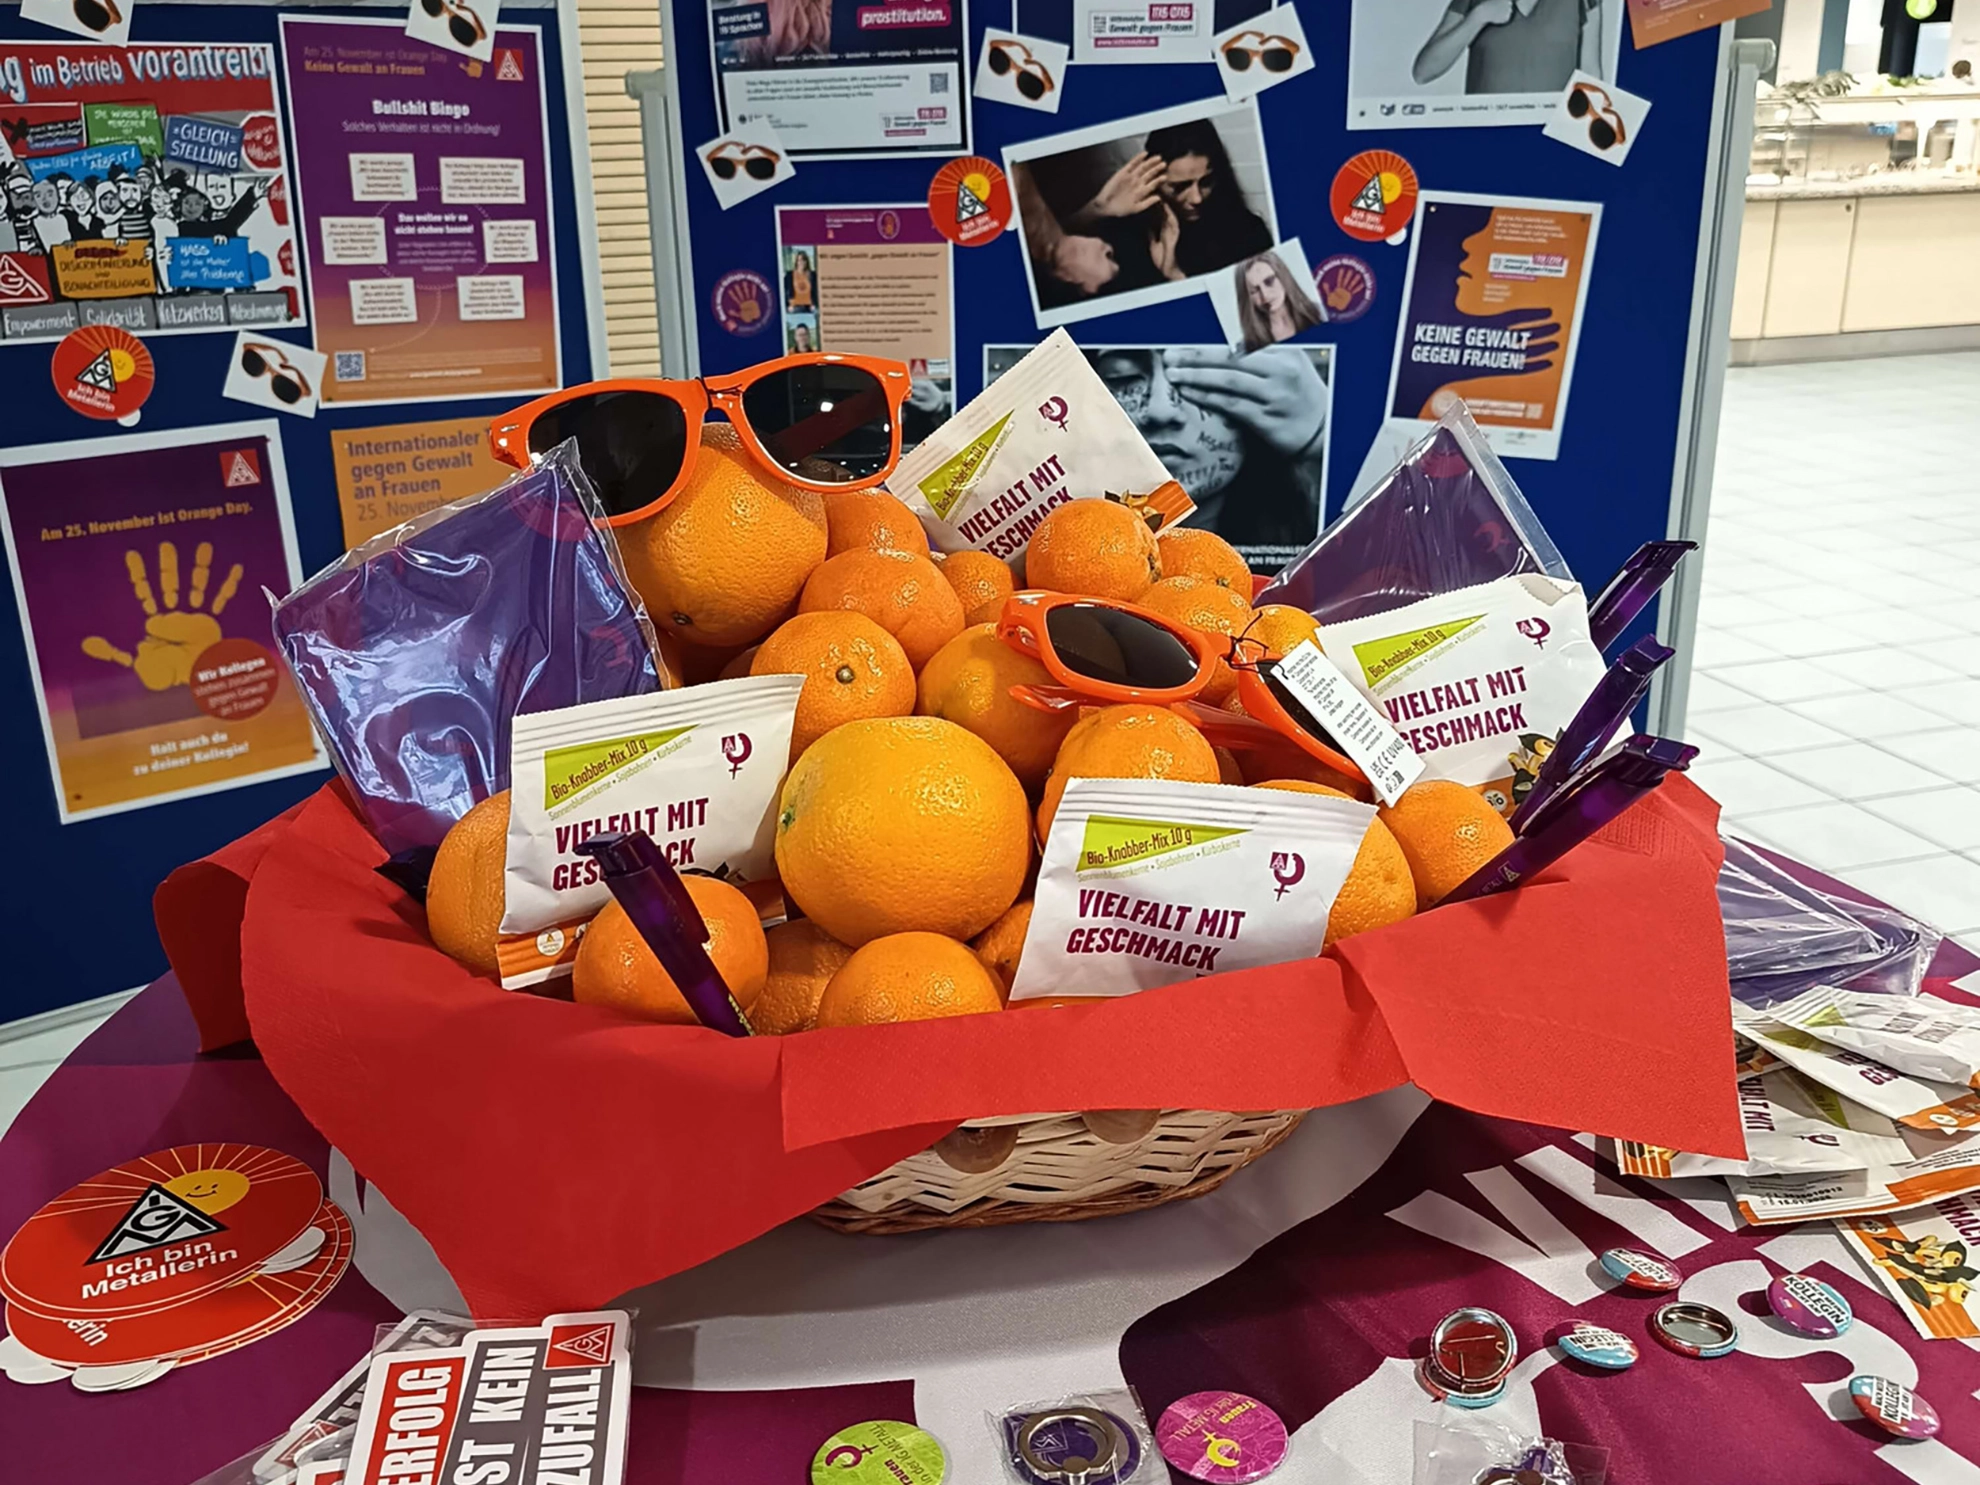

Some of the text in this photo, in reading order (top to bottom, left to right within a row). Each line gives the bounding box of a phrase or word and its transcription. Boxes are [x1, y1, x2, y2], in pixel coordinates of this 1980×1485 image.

[861, 8, 947, 27] prostitution.
[28, 46, 270, 90] im Betrieb vorantreib
[304, 60, 334, 73] Keine
[336, 61, 373, 74] Gewalt
[389, 63, 426, 76] Frauen
[372, 99, 470, 119] Bullshit Bingo
[180, 122, 230, 146] GLEICH
[169, 140, 239, 168] STELLUNG
[1414, 323, 1532, 350] KEINE GEWALT
[1411, 345, 1526, 370] GEGEN FRAUEN!
[348, 431, 482, 458] Internationaler
[351, 452, 474, 483] gegen Gewalt
[354, 477, 441, 500] an Frauen
[958, 480, 1033, 544] VIELFALT
[1028, 454, 1067, 493] MIT
[41, 501, 253, 542] Am 25. November ist Orange Day.
[387, 496, 456, 518] Novem
[1367, 638, 1429, 678] Bio-Knabber-Mix
[1423, 631, 1438, 645] 10
[1383, 676, 1481, 724] VIELFALT
[1486, 666, 1528, 697] MIT
[150, 739, 178, 756] Halt
[180, 733, 211, 752] auch
[150, 757, 191, 774] deiner
[194, 741, 249, 766] Kollegin!
[550, 738, 648, 800] Bio-Knabber-Mix 10 g
[549, 780, 613, 822] Sonnenblumenkerne
[667, 798, 710, 833] MIT
[1086, 826, 1193, 866] Bio-Knabber-Mix 10 g
[553, 838, 696, 892] GESCK
[1077, 864, 1150, 883] Sonnenblumenkerne
[1078, 888, 1247, 940] VIELFALT MIT
[1065, 927, 1222, 971] GESCHMACK
[1743, 1110, 1777, 1132] MIT
[80, 1246, 239, 1300] Metallerin
[105, 1240, 213, 1278] Ich bin
[1784, 1276, 1845, 1324] KOLLEGIN
[378, 1366, 452, 1485] ERFOLG
[453, 1346, 537, 1485] ST KEIN
[536, 1368, 602, 1485] ZUFALL
[1219, 1400, 1257, 1424] Frauen
[868, 1424, 901, 1452] METALL
[1168, 1414, 1208, 1442] METALL
[884, 1458, 914, 1485] rauen
[895, 1450, 912, 1464] IG
[907, 1459, 925, 1475] der
